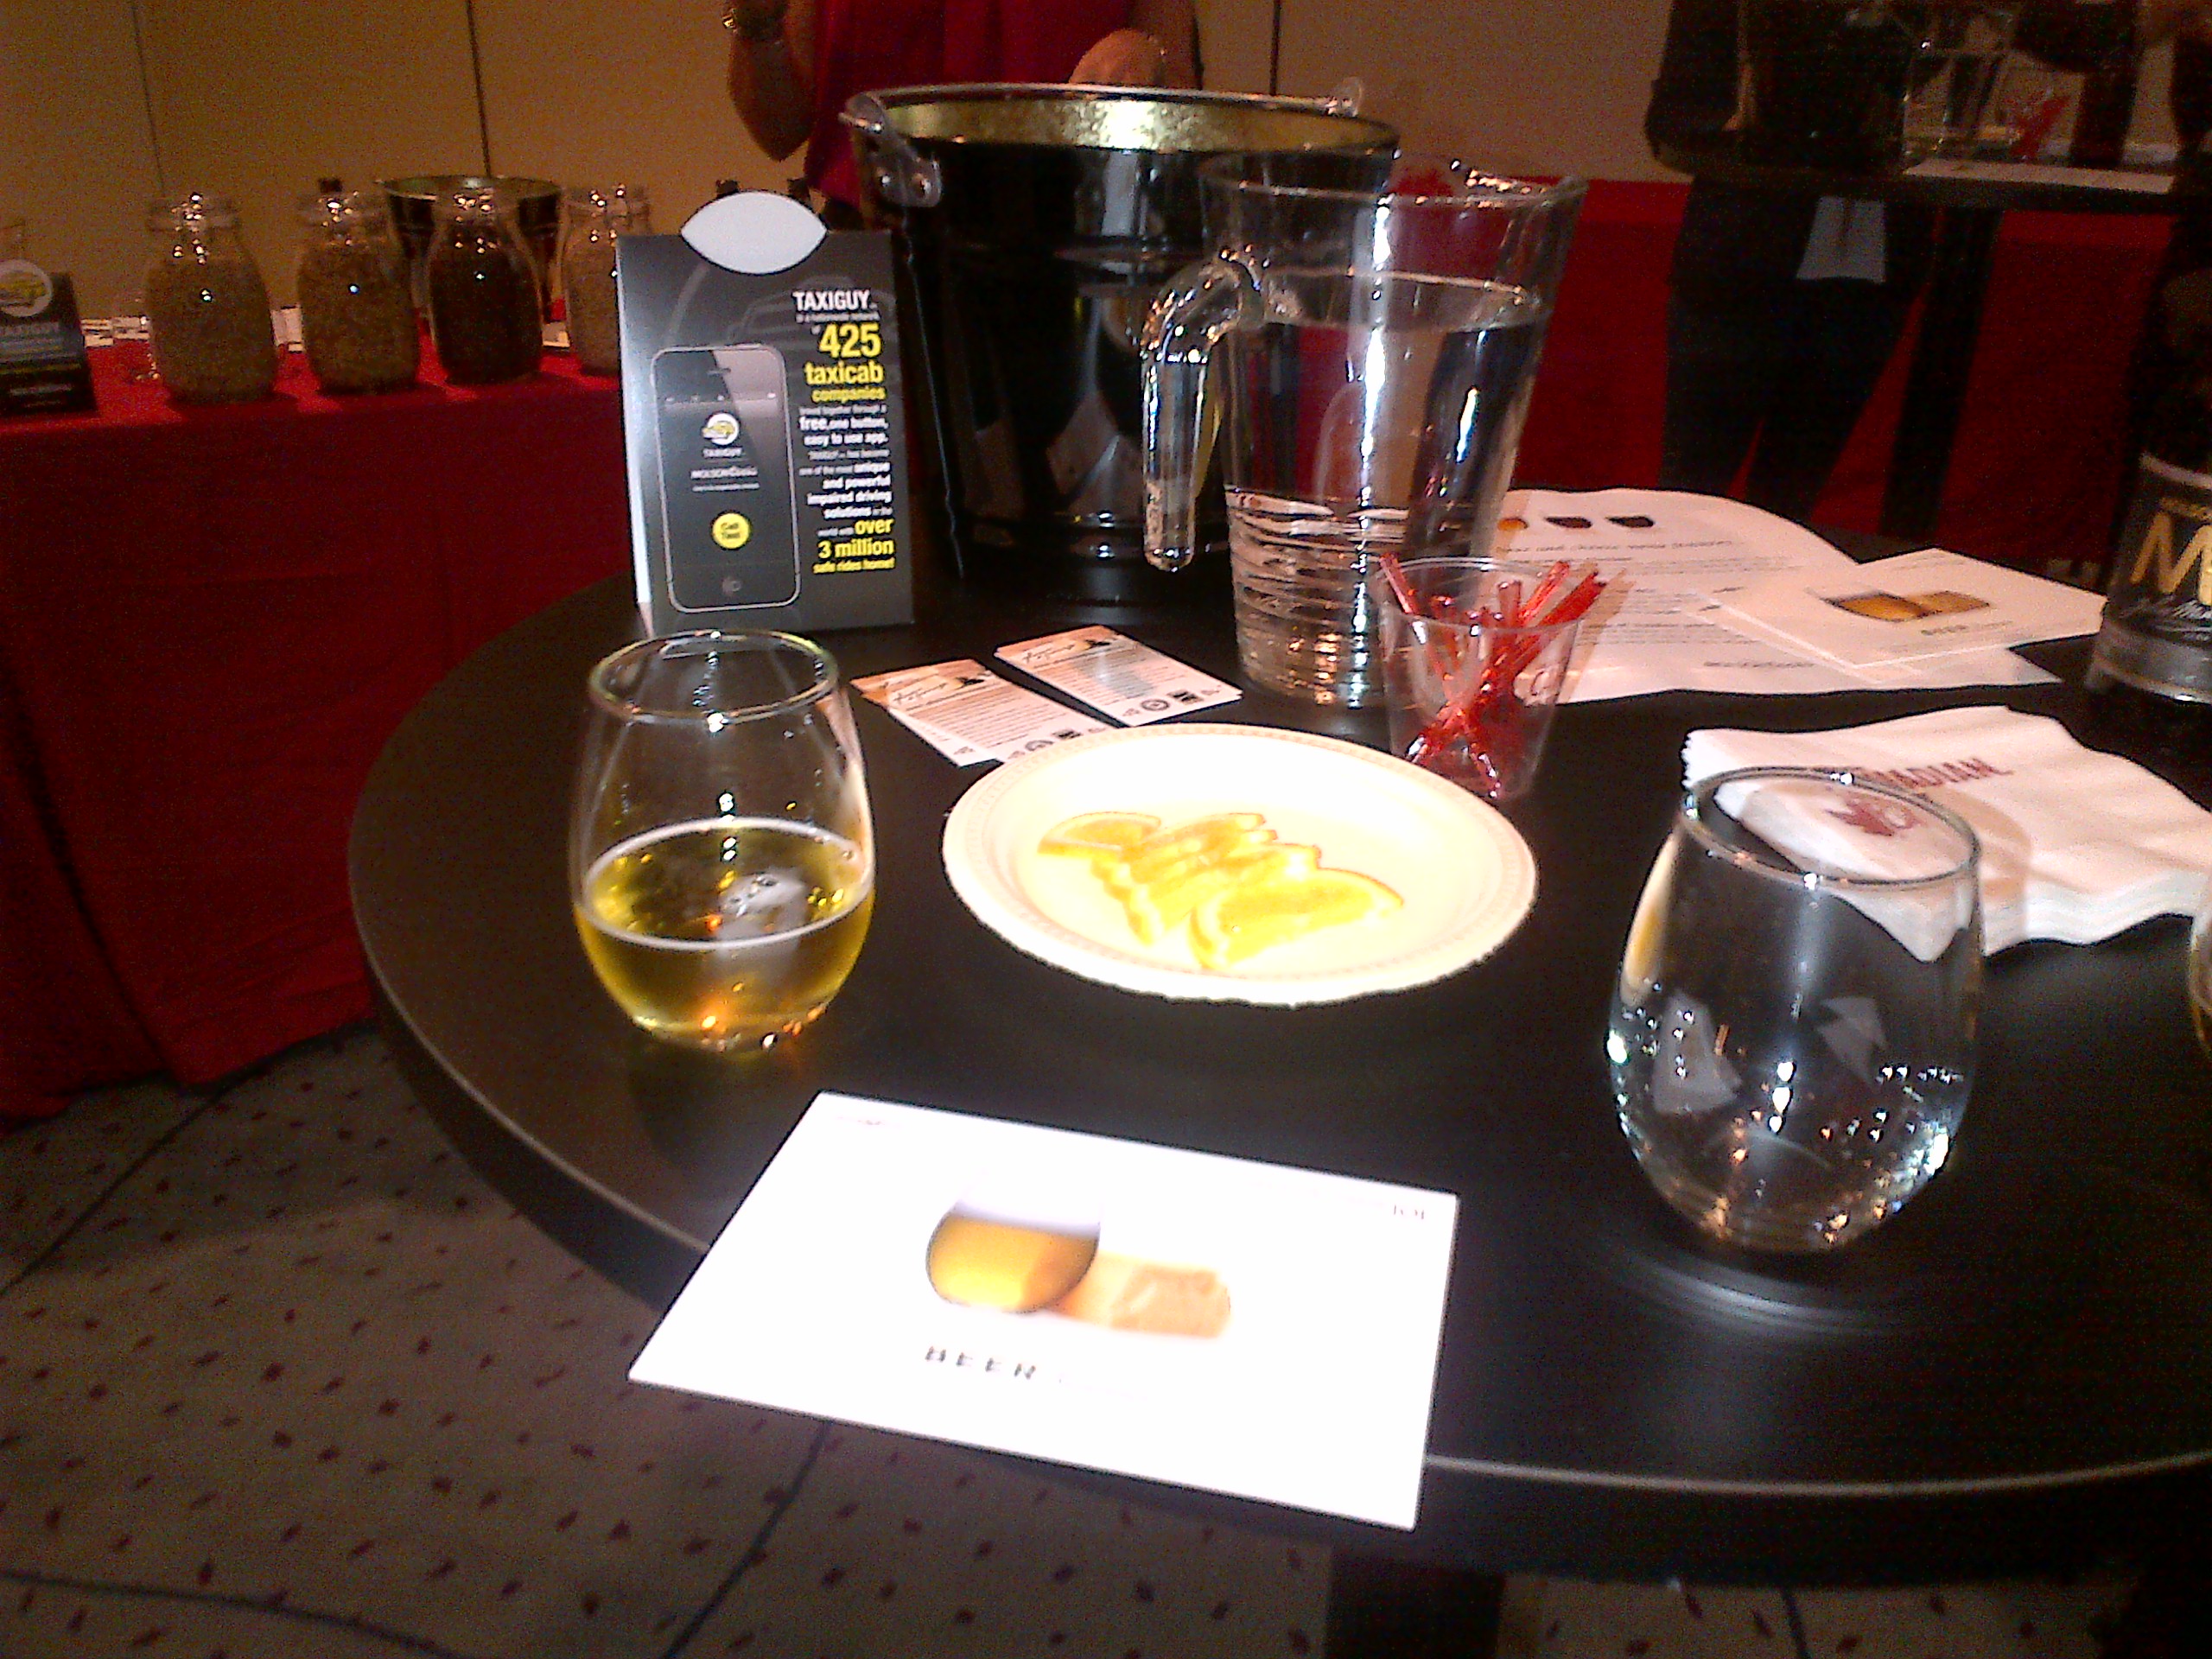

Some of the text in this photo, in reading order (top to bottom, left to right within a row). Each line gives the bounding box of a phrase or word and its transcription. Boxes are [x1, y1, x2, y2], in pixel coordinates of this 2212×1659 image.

[792, 289, 870, 311] TAXIGUY
[819, 322, 882, 358] 425
[804, 359, 884, 385] taxicab
[810, 386, 887, 404] companies
[854, 518, 895, 535] over
[817, 537, 895, 559] 3 million
